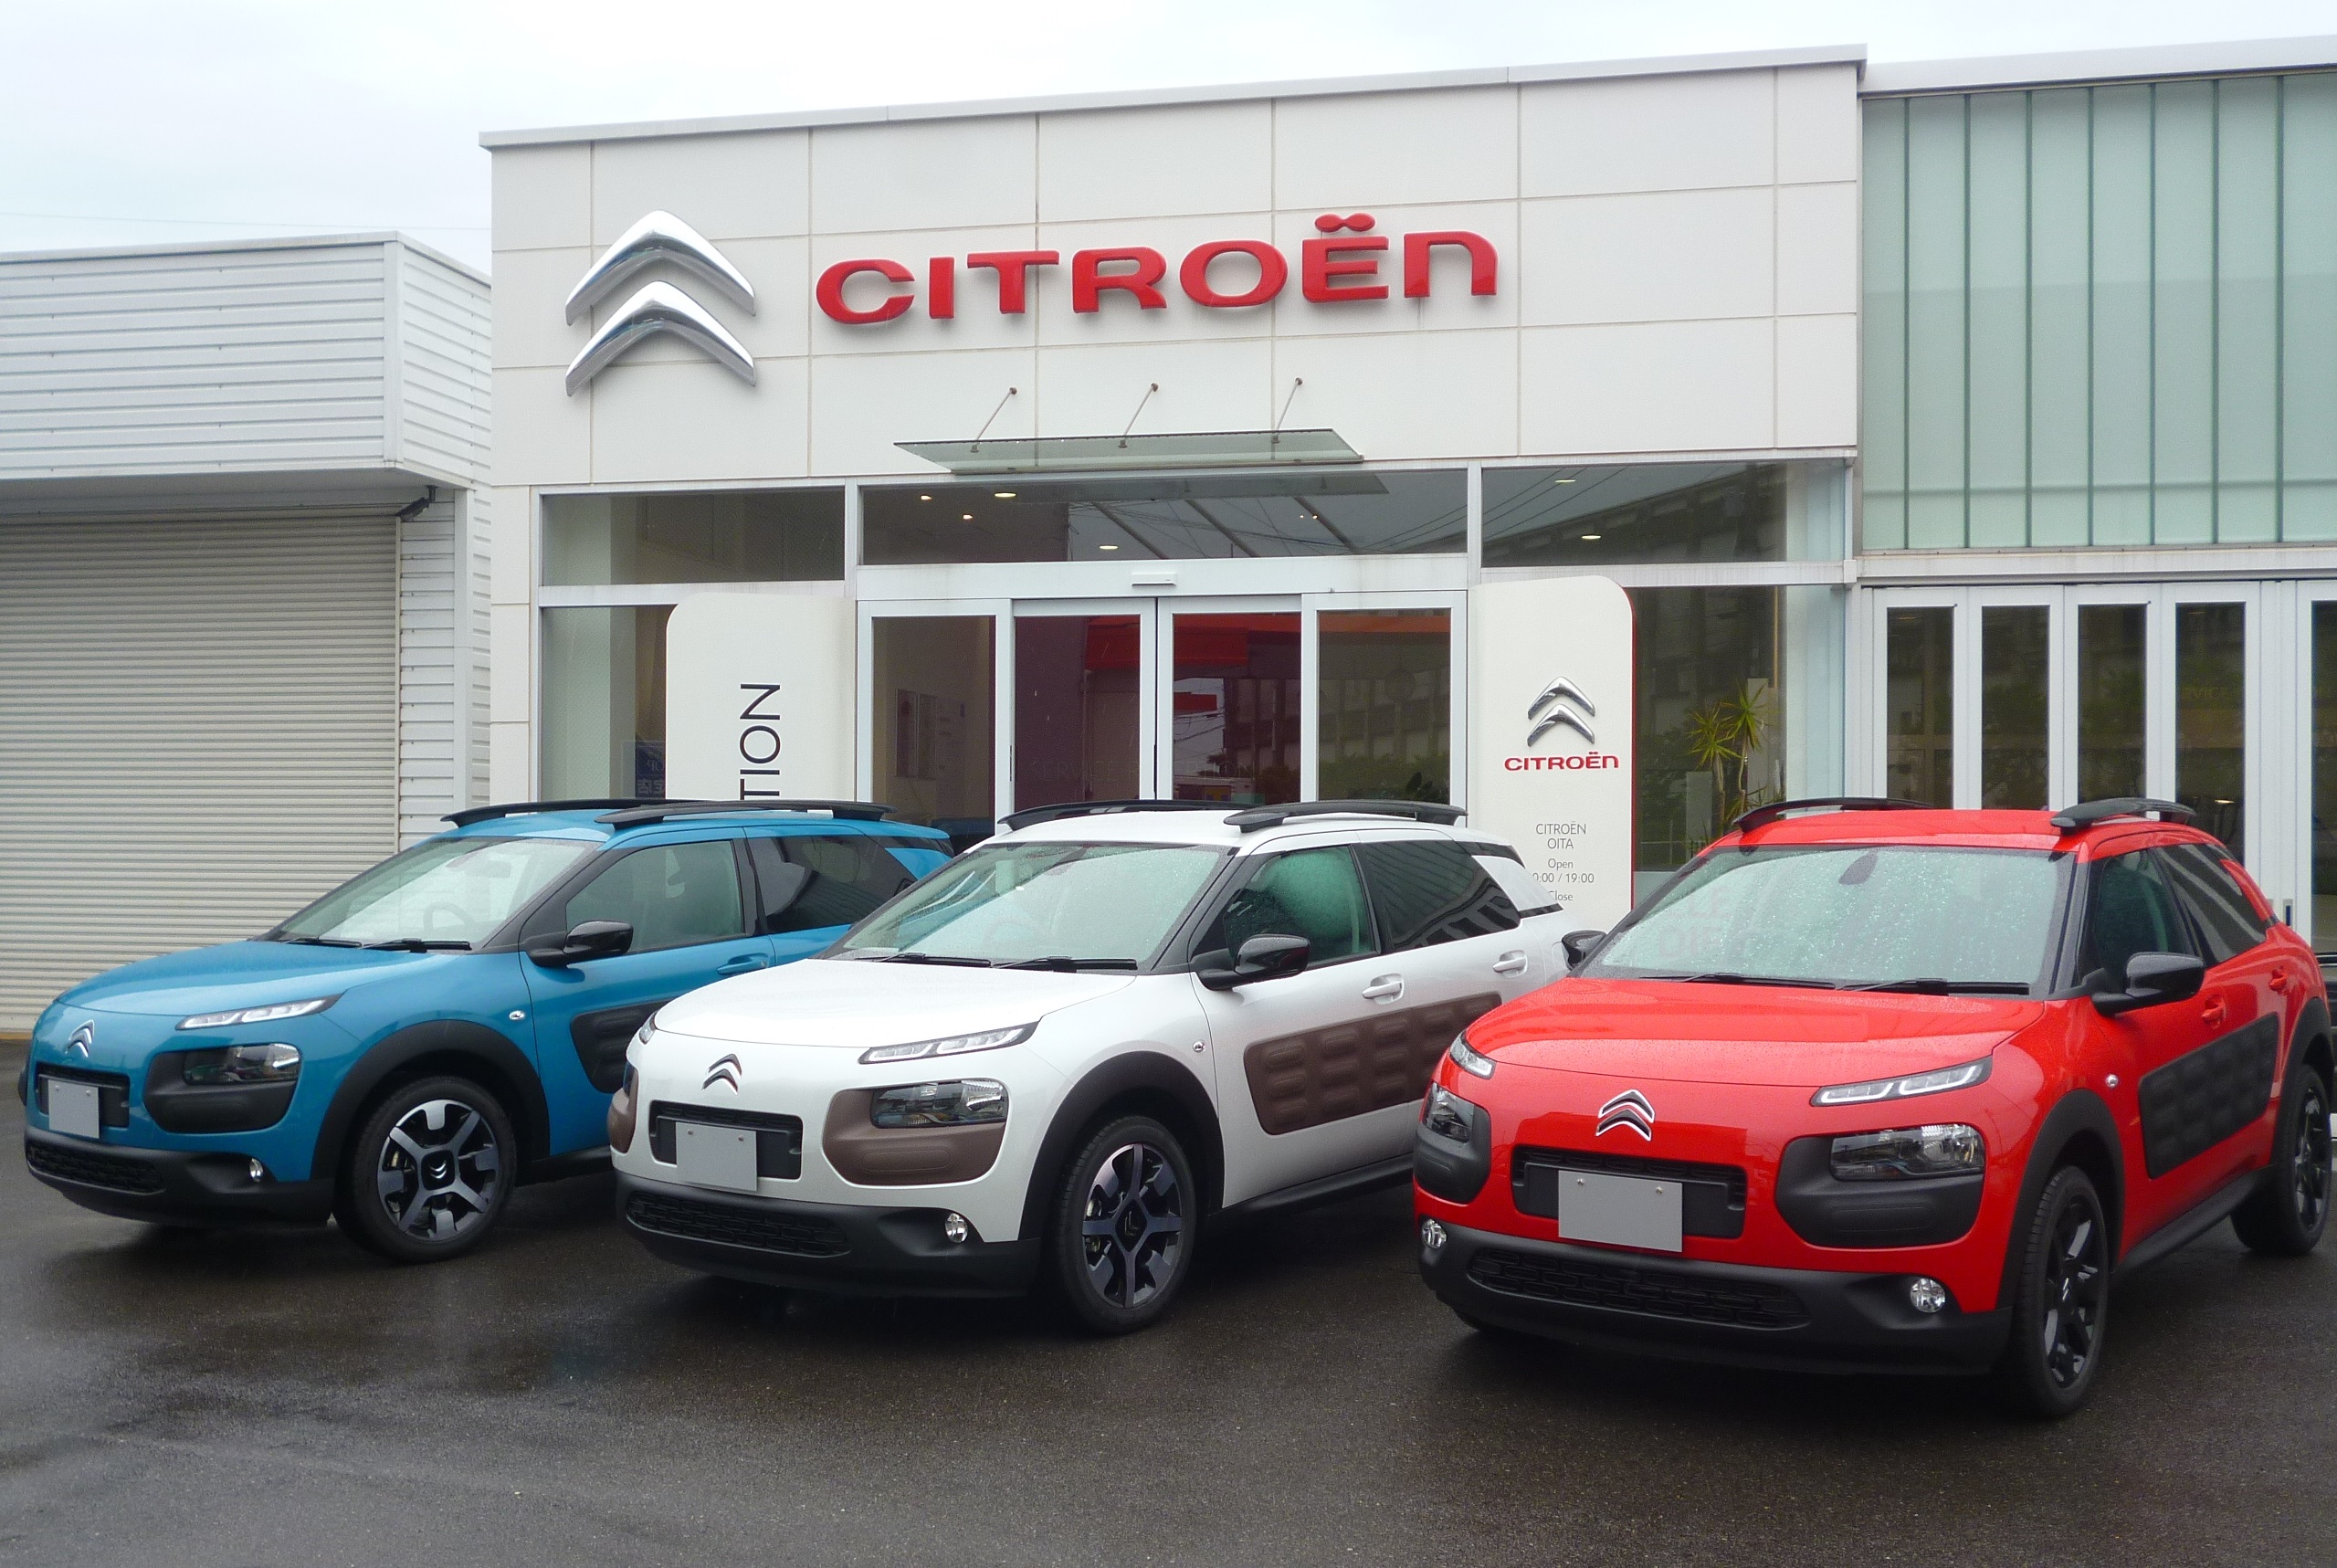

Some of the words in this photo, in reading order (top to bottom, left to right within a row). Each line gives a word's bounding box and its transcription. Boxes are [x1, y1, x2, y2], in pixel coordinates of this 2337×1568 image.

[1535, 821, 1586, 835] CITROËN
[1547, 838, 1574, 849] OITA
[1547, 858, 1574, 871] Open
[1565, 872, 1595, 884] 19:00
[1548, 889, 1574, 901] lose
